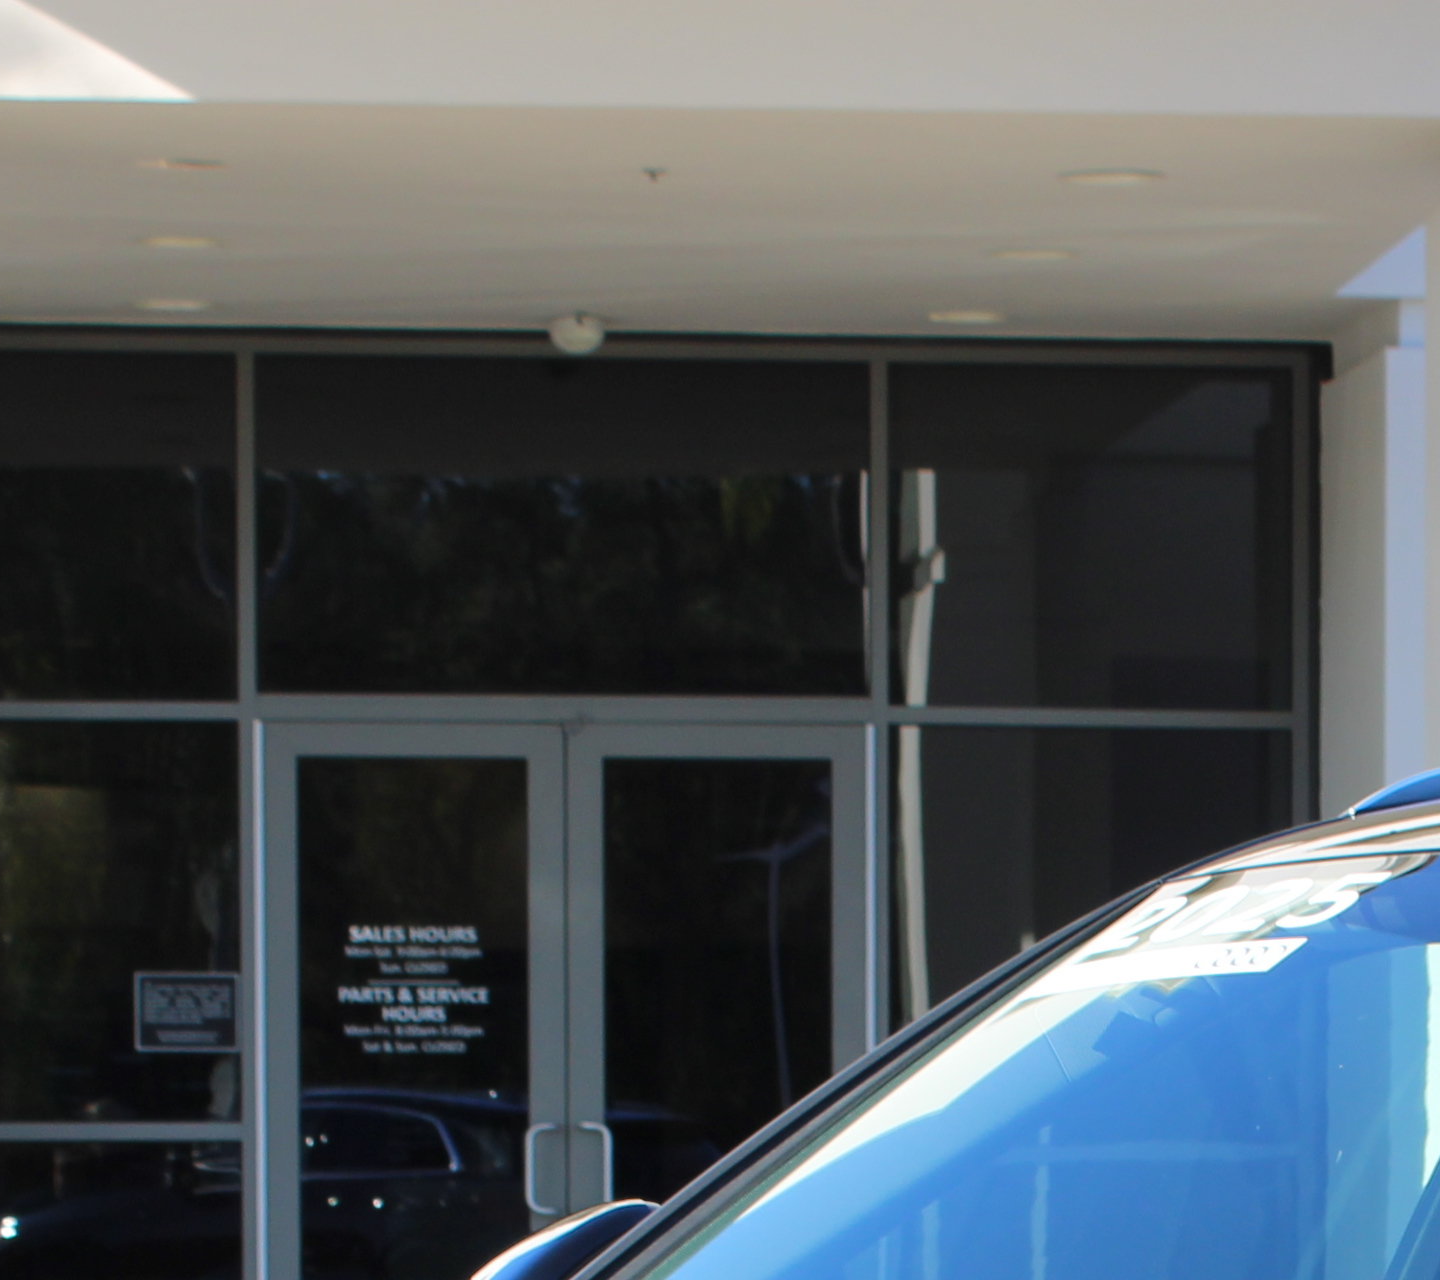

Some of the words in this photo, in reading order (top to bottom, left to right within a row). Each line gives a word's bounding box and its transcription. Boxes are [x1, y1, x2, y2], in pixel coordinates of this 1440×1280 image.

[1086, 872, 1392, 957] 2025
[349, 925, 406, 943] SALES
[409, 926, 478, 943] HOURS
[337, 987, 394, 1003] PARTS
[398, 987, 413, 1004] &
[417, 987, 490, 1004] SERVICE
[381, 1006, 447, 1022] HOURS
